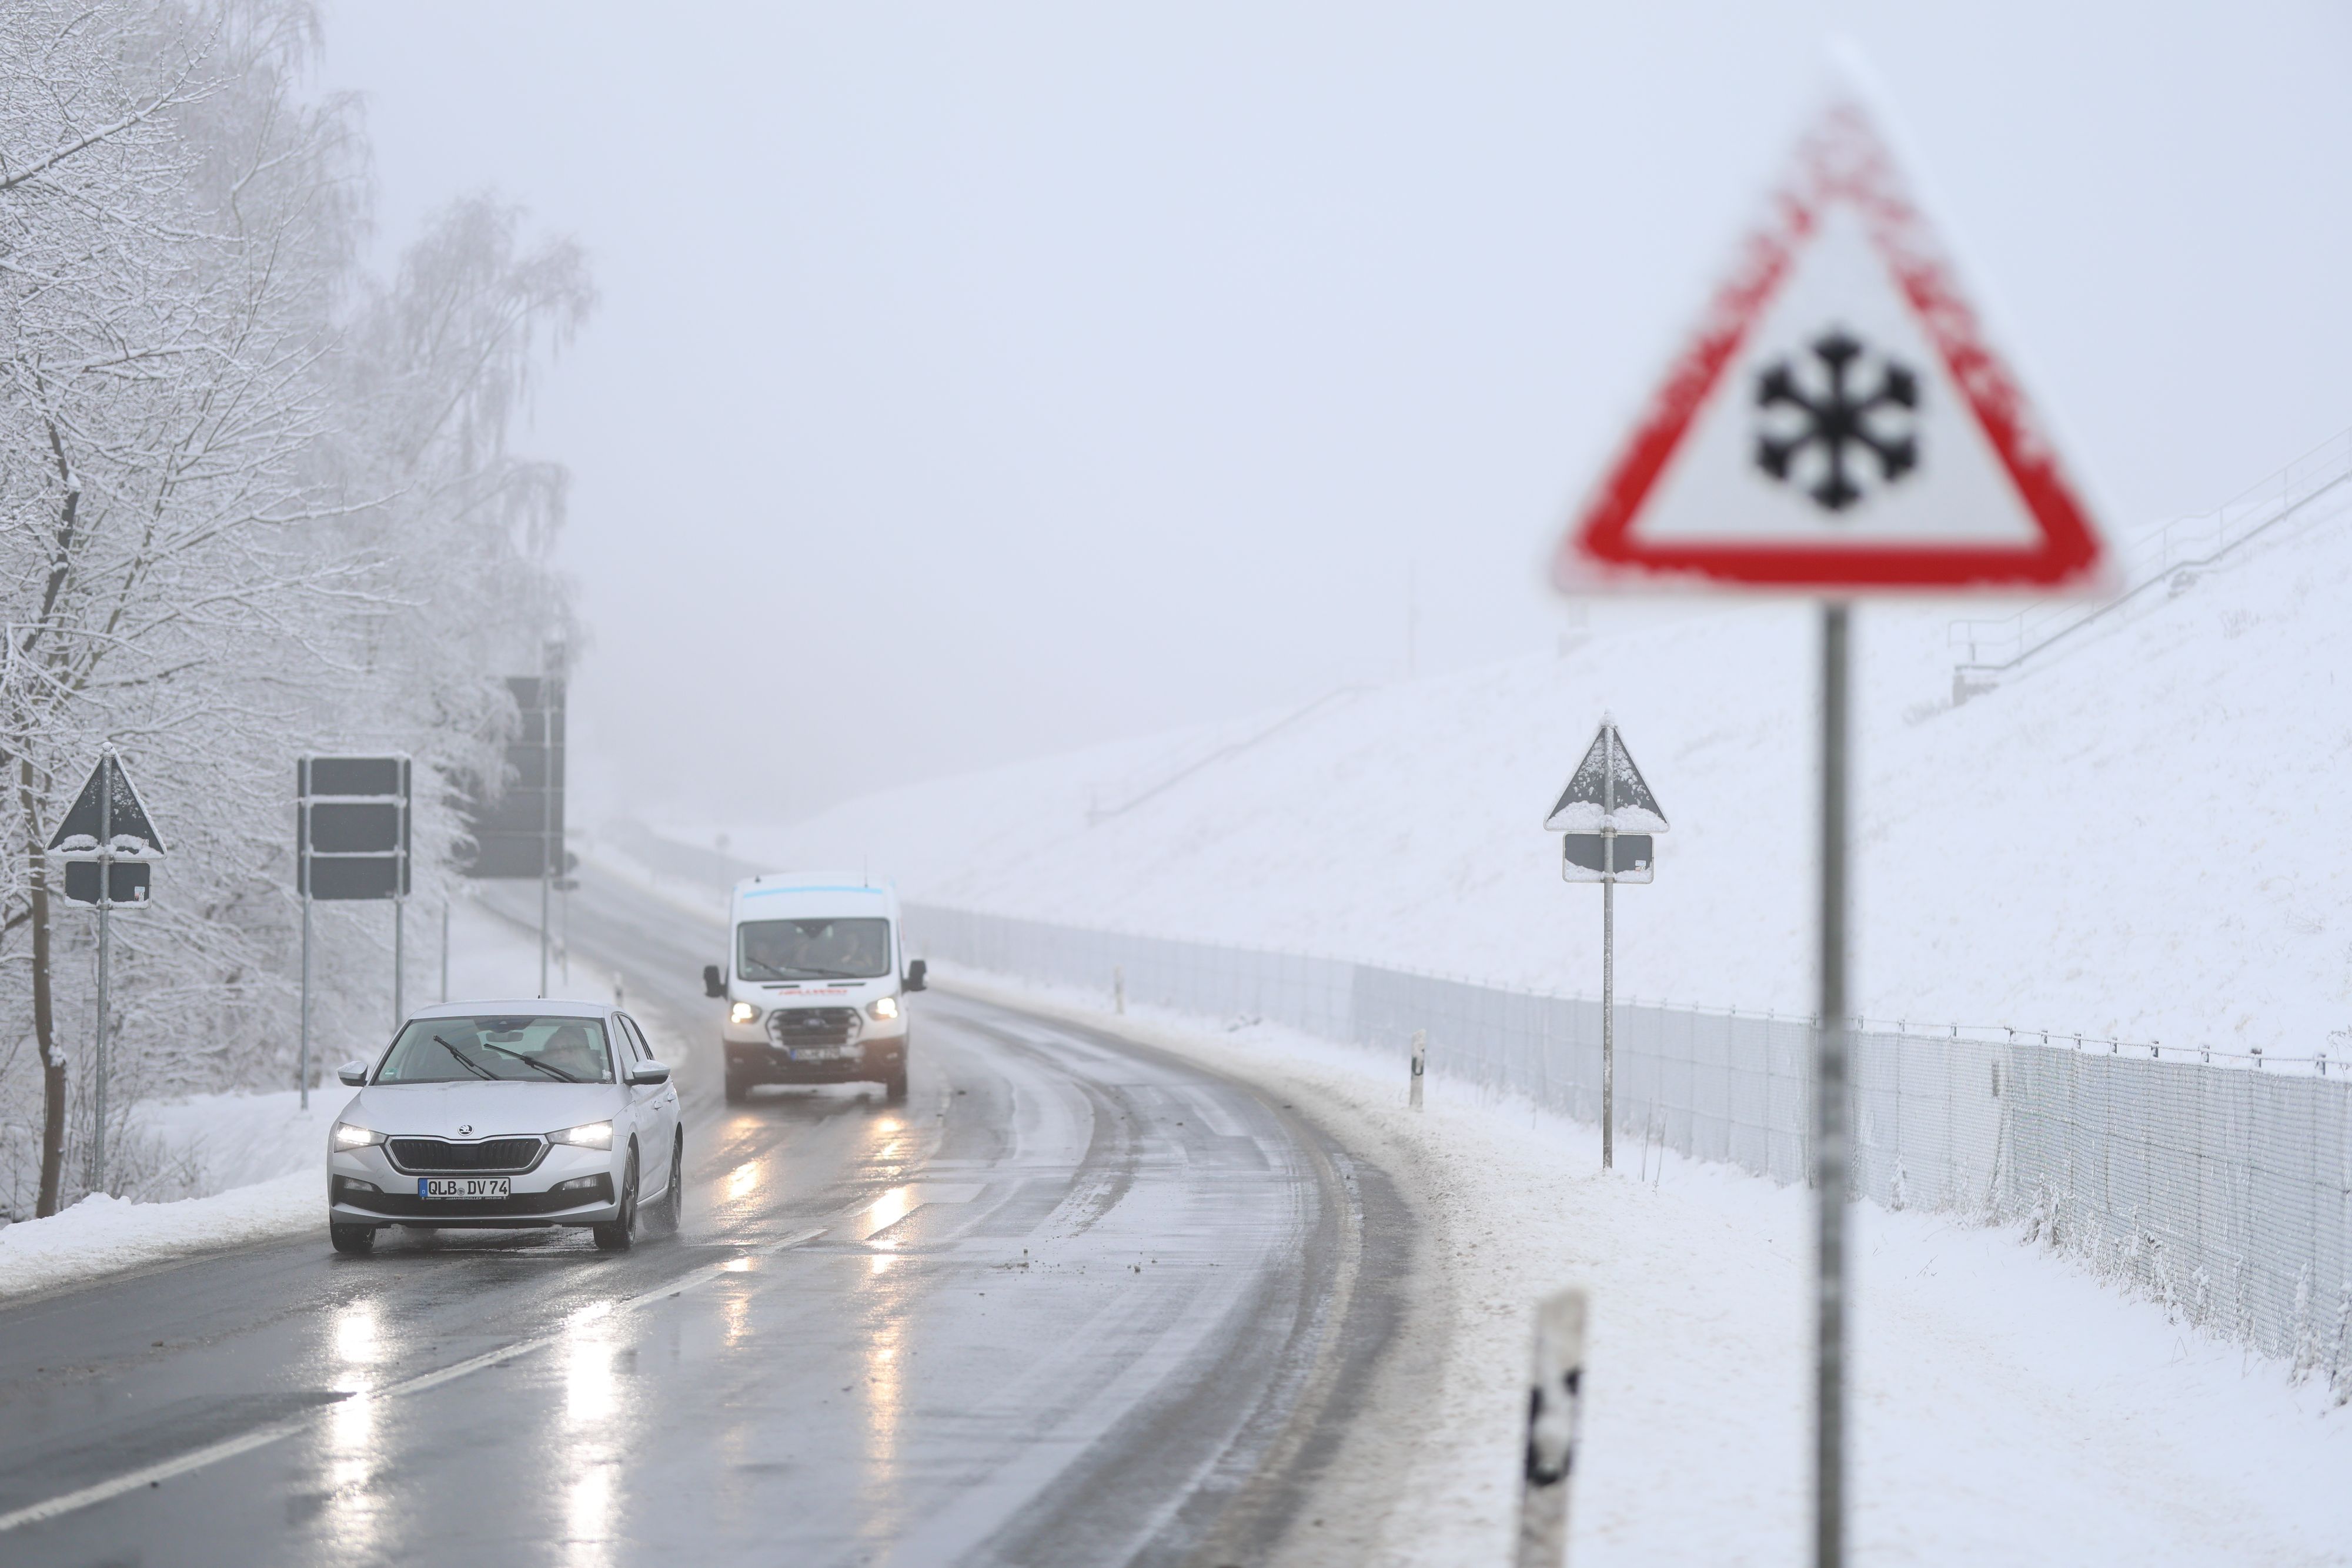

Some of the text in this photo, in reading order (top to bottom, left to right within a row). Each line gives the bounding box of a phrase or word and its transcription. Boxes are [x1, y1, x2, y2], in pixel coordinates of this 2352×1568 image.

[429, 1181, 507, 1195] QLB DV 74
